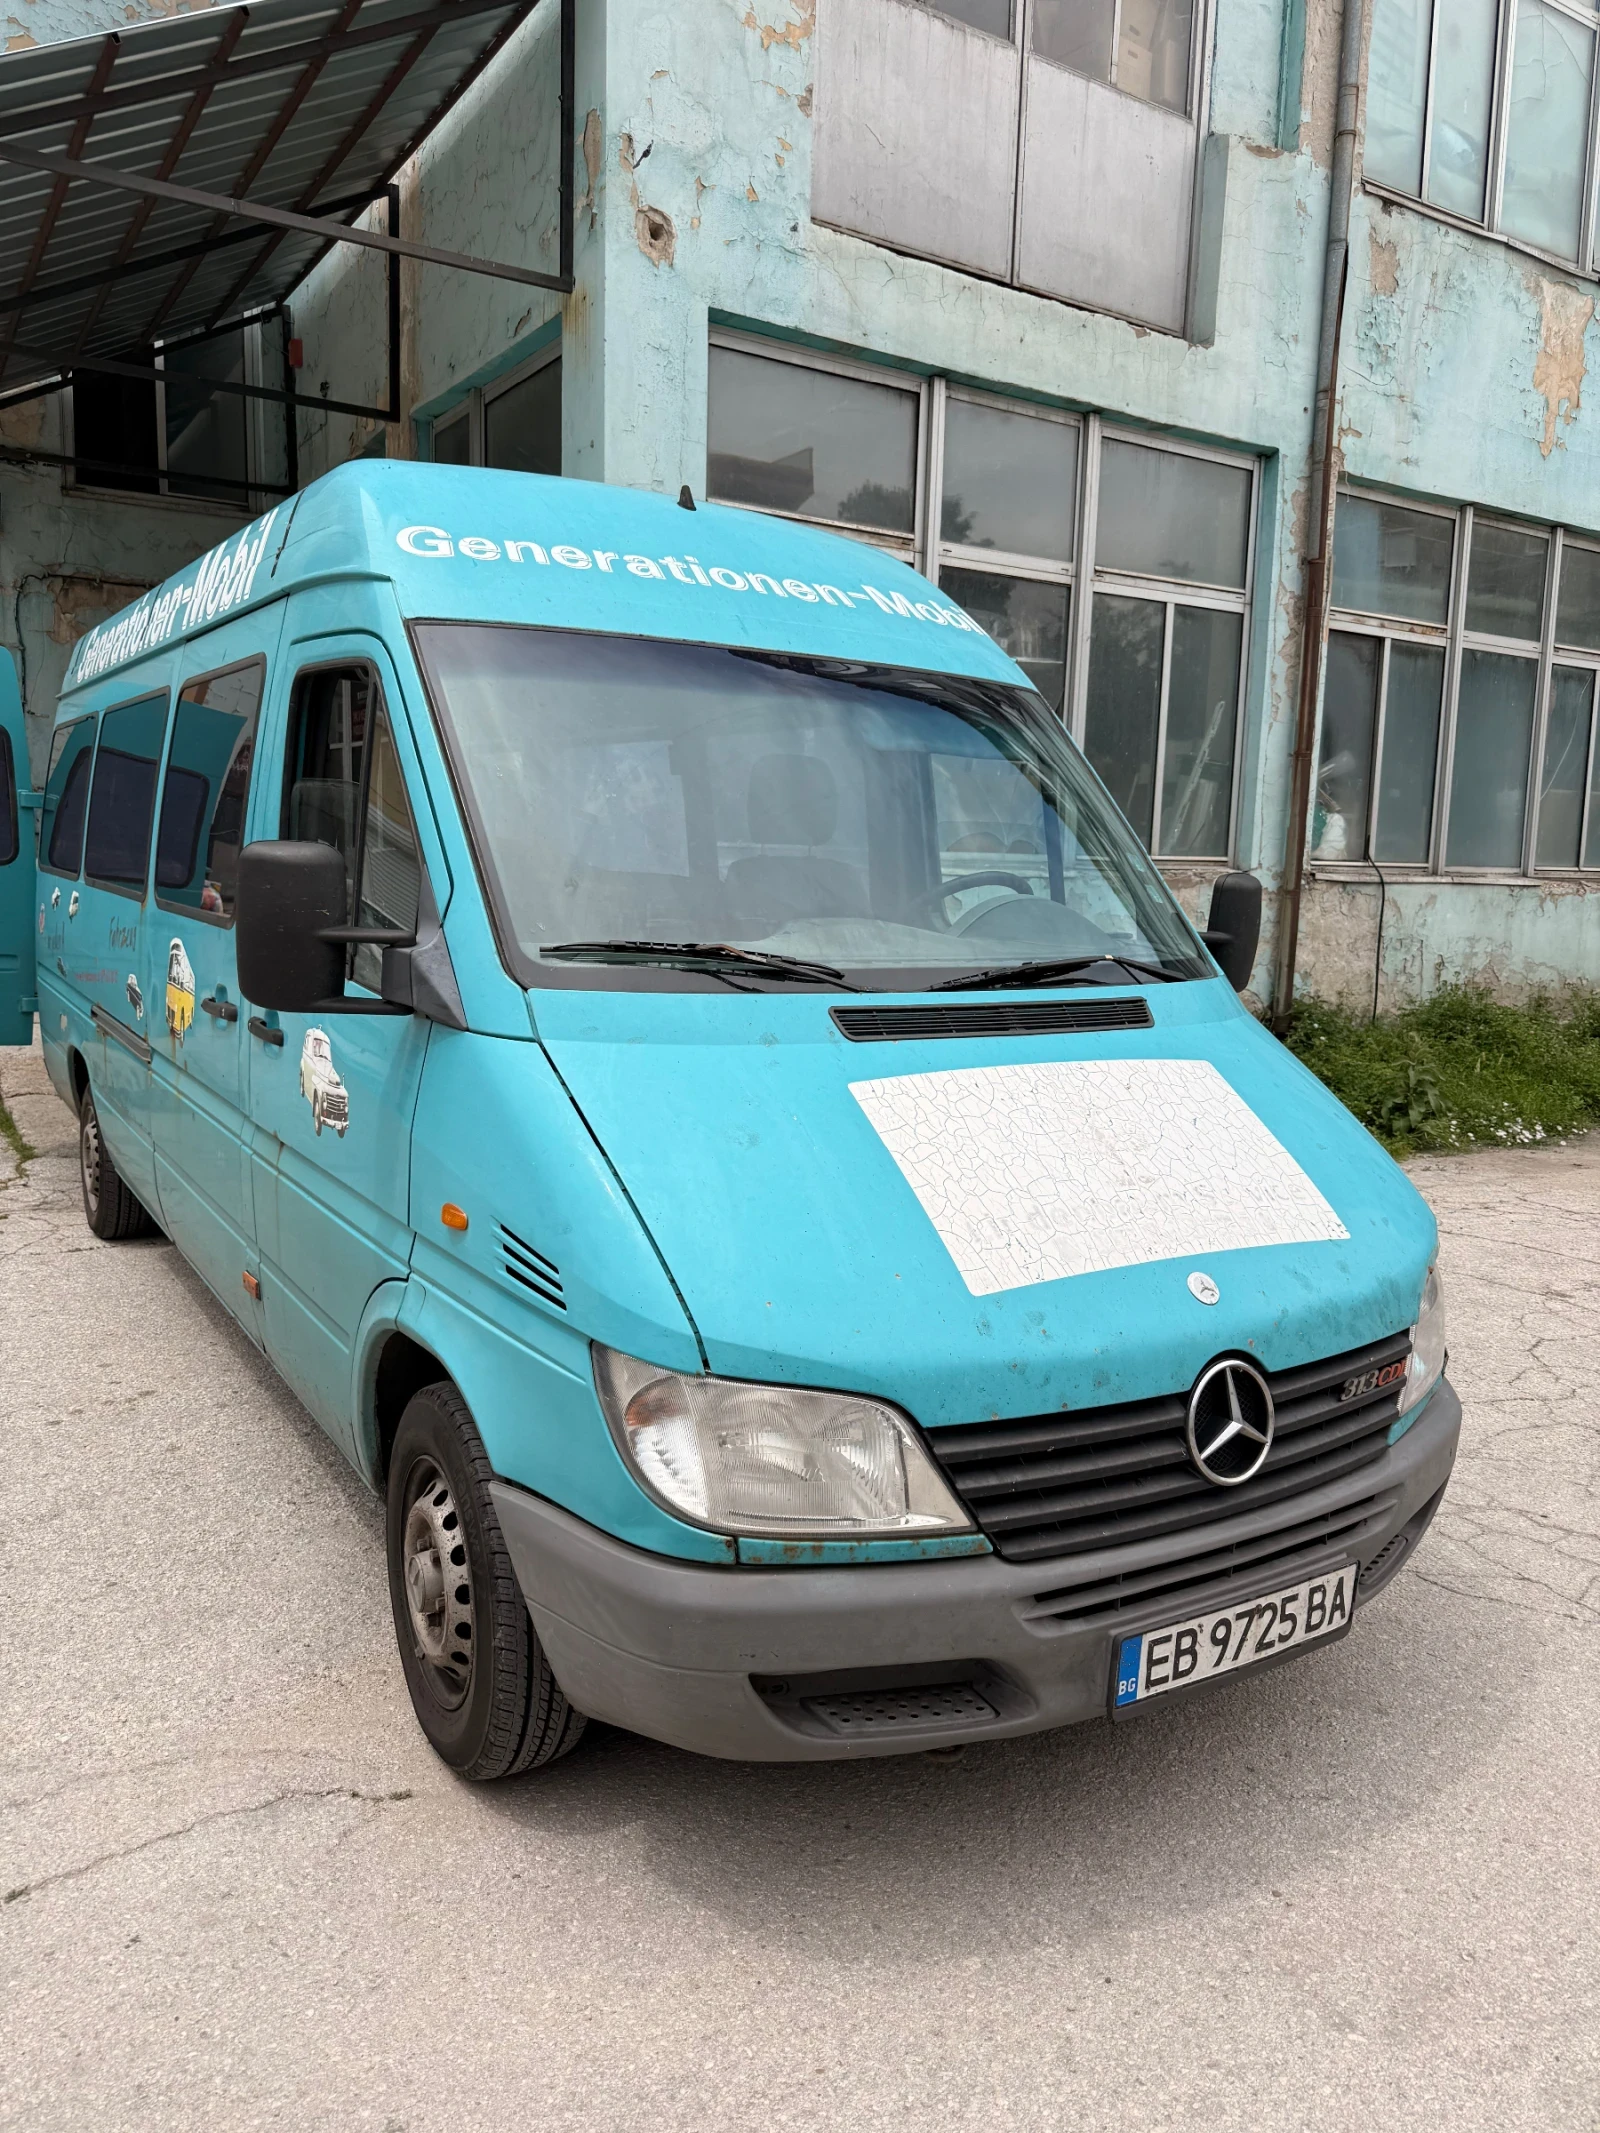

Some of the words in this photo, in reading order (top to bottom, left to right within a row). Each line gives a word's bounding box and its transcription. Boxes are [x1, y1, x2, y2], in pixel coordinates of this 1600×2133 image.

[395, 525, 990, 638] Generationen-Mobil
[1117, 1677, 1136, 1696] BG
[1145, 1627, 1198, 1690] EB
[1209, 1592, 1300, 1668] 9725
[1304, 1575, 1346, 1635] BA
